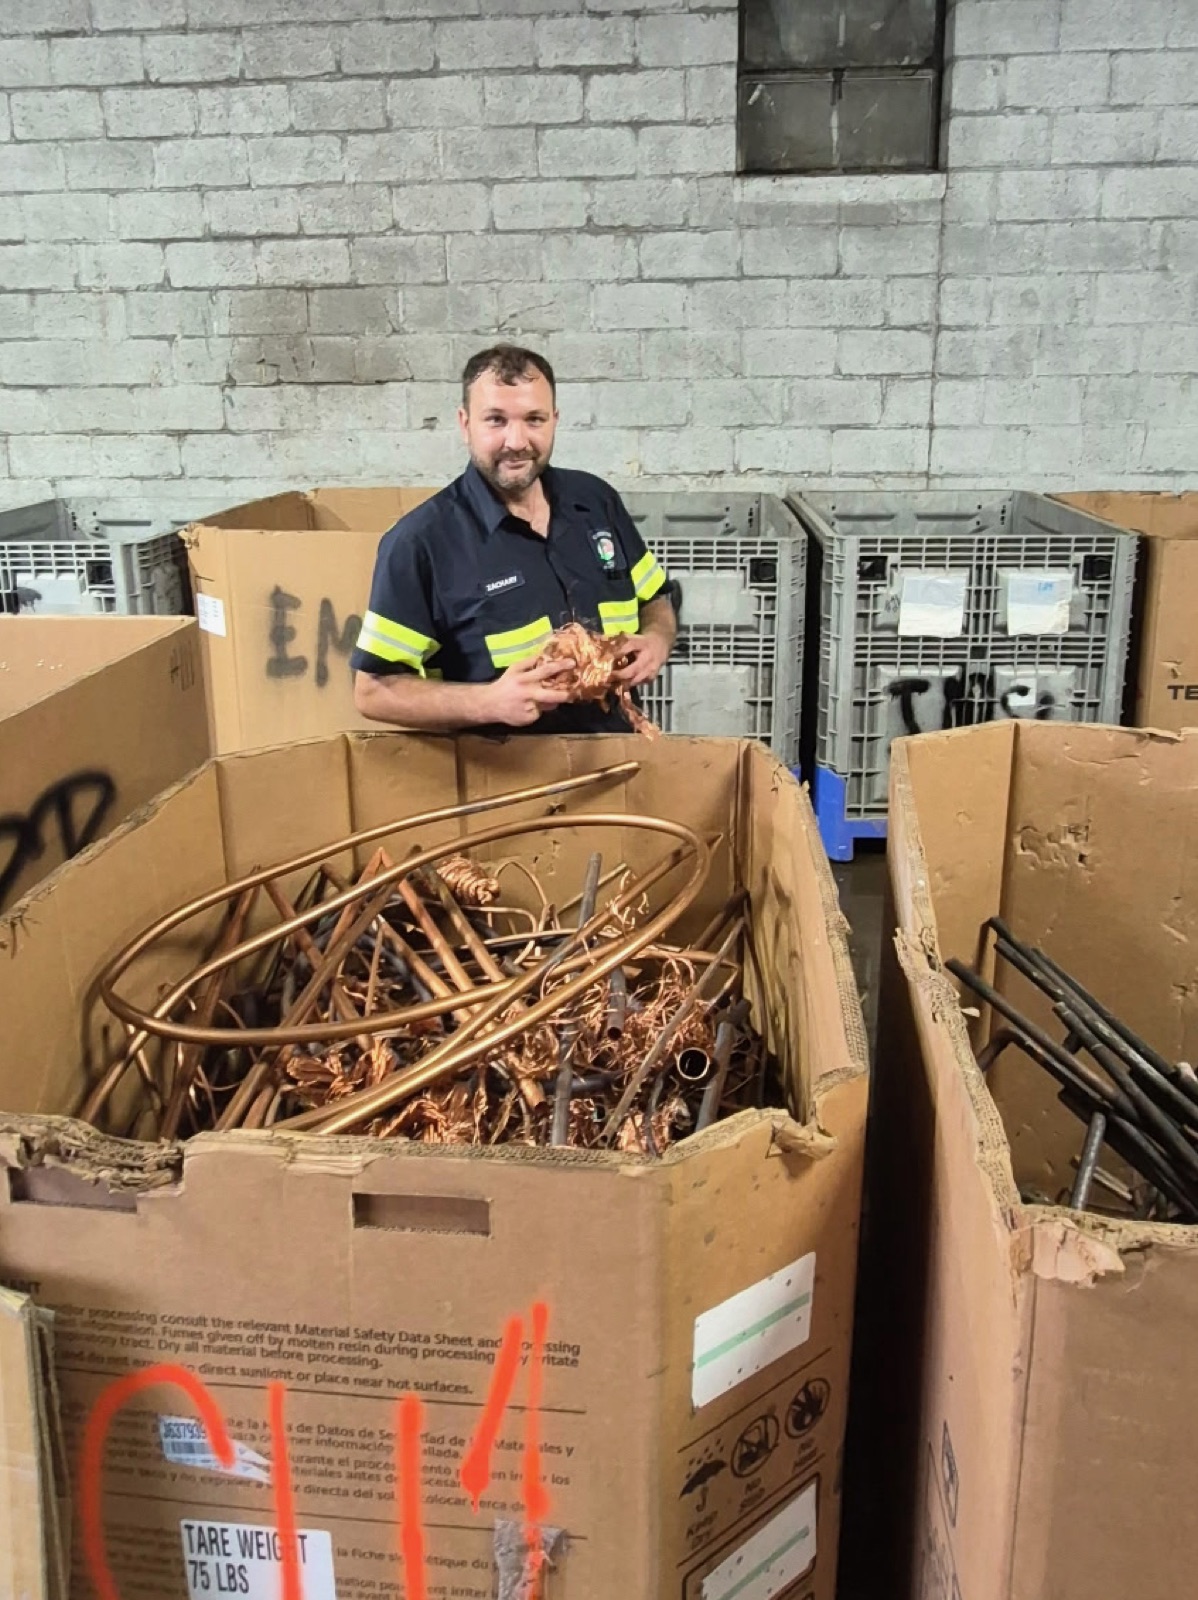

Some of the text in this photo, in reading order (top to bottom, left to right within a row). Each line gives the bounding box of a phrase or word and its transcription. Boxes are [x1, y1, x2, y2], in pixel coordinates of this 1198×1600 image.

[161, 1313, 208, 1328] consult
[211, 1317, 233, 1329] the
[237, 1319, 291, 1334] relevant
[295, 1323, 350, 1338] Material
[353, 1328, 395, 1344] Safety
[399, 1331, 431, 1345] Data
[434, 1333, 472, 1347] Sheet
[162, 1327, 204, 1340] Fumes
[207, 1330, 243, 1344] given
[246, 1332, 265, 1345] off
[268, 1334, 284, 1351] by
[288, 1335, 335, 1350] molten
[338, 1341, 371, 1354] resin
[375, 1343, 418, 1359] during
[422, 1348, 495, 1364] processing
[158, 1338, 180, 1355] Dry
[184, 1340, 199, 1353] all
[203, 1344, 257, 1358] material
[260, 1347, 304, 1362] before
[308, 1352, 383, 1369] processing.
[199, 1363, 236, 1377] direct
[240, 1365, 293, 1381] sunlight
[297, 1371, 310, 1382] or
[314, 1370, 350, 1385] place
[353, 1376, 383, 1388] near
[387, 1377, 409, 1390] hot
[413, 1380, 474, 1395] surfaces.
[296, 1423, 313, 1434] de
[317, 1424, 355, 1438] Datos
[358, 1428, 376, 1440] de
[448, 1435, 466, 1447] de
[338, 1456, 350, 1467] el
[551, 1472, 571, 1485] los
[303, 1484, 350, 1498] directa
[353, 1487, 374, 1499] del
[184, 1524, 233, 1558] TARE
[236, 1528, 308, 1563] WEIGT
[188, 1559, 210, 1590] 75
[215, 1562, 250, 1594] LBS
